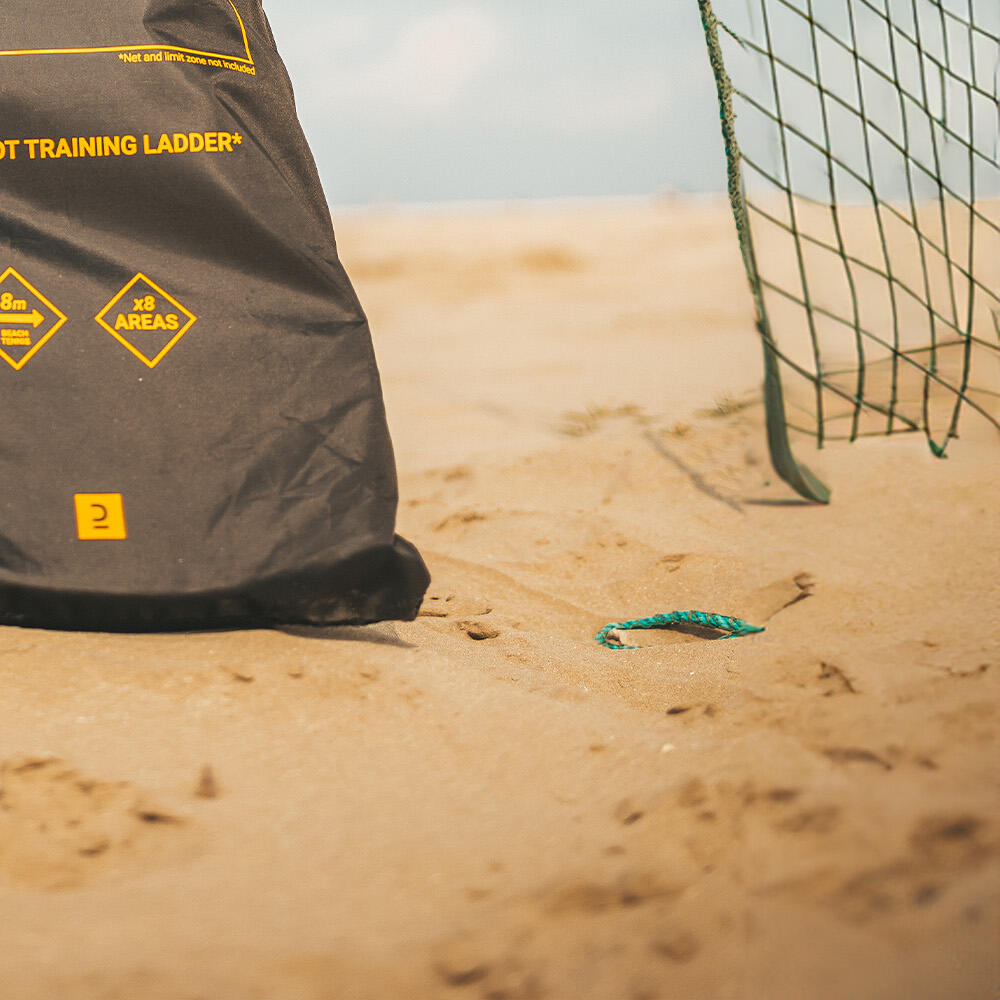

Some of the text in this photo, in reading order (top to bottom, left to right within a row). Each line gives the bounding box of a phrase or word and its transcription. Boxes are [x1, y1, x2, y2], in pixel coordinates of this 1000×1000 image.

[143, 51, 163, 62] and
[164, 51, 185, 62] limit
[185, 55, 207, 65] zone
[208, 59, 222, 68] not
[222, 60, 256, 76] included
[23, 134, 138, 160] TRAINING
[0, 291, 28, 311] 8m
[132, 295, 156, 312] x8
[114, 313, 180, 331] AREAS
